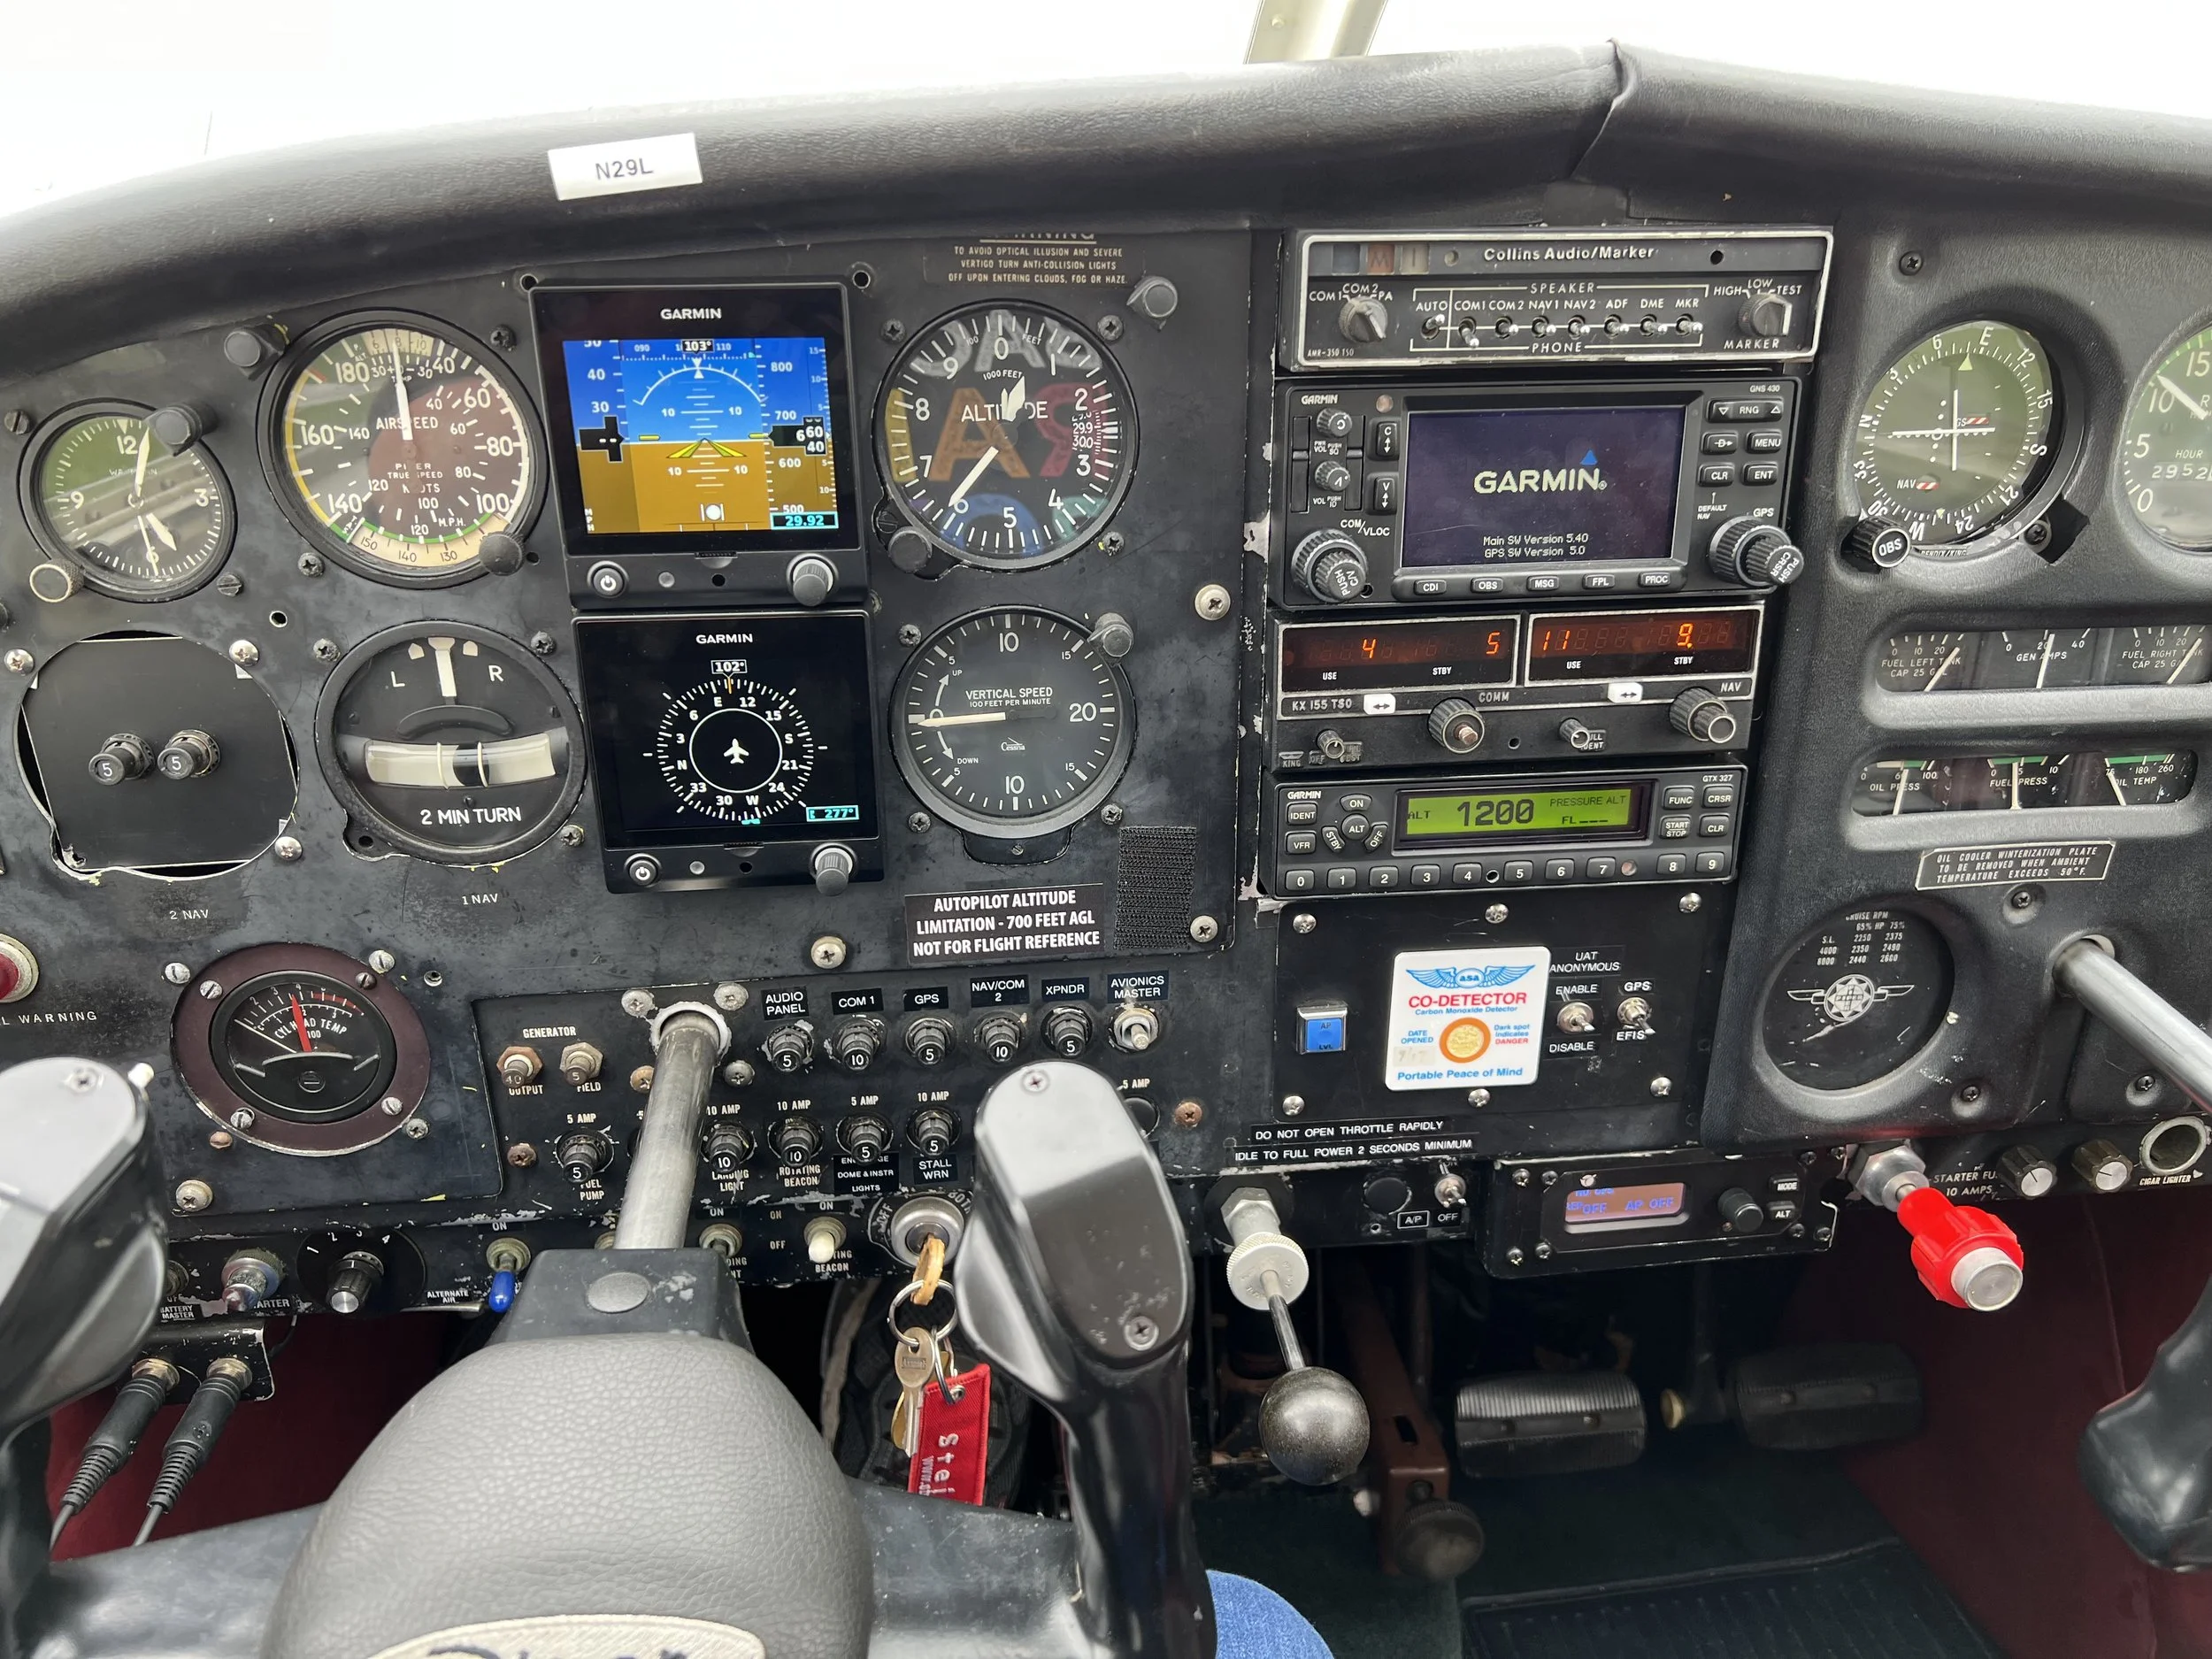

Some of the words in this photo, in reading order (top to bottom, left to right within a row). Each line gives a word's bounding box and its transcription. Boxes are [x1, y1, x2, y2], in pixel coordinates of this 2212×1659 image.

[595, 157, 654, 180] N29L
[954, 246, 964, 255] TO
[969, 246, 993, 256] AVOID
[996, 247, 1029, 256] OPTICAL
[1033, 247, 1069, 257] ILLUSION
[1073, 248, 1089, 257] AND
[1093, 248, 1123, 257] SEVERE
[1484, 248, 1540, 261] Collins
[1544, 246, 1655, 261] Audio/Marker
[961, 259, 994, 268] VERTIGO
[998, 259, 1018, 269] TURN
[1023, 260, 1085, 270] ANTI-COLLISION
[1088, 261, 1117, 271] LIGHTS
[949, 273, 963, 282] OFF
[967, 273, 988, 282] UPON
[992, 273, 1030, 283] ENTERING
[1071, 274, 1087, 284] FOG
[1091, 275, 1102, 284] OR
[1747, 279, 1772, 289] LOW
[1530, 282, 1594, 295] SPEAKER
[1714, 286, 1741, 296] HIGH
[1776, 285, 1802, 296] TEST
[1416, 301, 1448, 311] AUTO
[1605, 299, 1628, 309] ADF
[1640, 298, 1664, 309] DME
[1675, 298, 1699, 308] MKR
[660, 308, 722, 320] GARMIN
[1532, 342, 1582, 353] PHONE
[1724, 338, 1780, 349] MARKER
[335, 362, 370, 383] 180
[915, 397, 930, 421] 8
[1739, 406, 1759, 415] RNG
[301, 425, 334, 445] 160
[117, 435, 138, 455] 12
[487, 436, 514, 457] 80
[1755, 438, 1781, 448] MENU
[2175, 449, 2203, 460] HOUR
[1473, 468, 1600, 494] GARMIN
[1711, 471, 1728, 480] CLR
[1754, 470, 1773, 480] ENT
[785, 515, 825, 527] 29.92
[1483, 535, 1504, 546] Main
[1507, 535, 1522, 545] SW
[1524, 534, 1563, 545] Version
[1565, 533, 1589, 543] 5.40
[1485, 548, 1505, 558] GPS
[1507, 548, 1522, 557] SW
[1524, 546, 1563, 557] Version
[1570, 545, 1586, 556] 5.0
[1878, 537, 1902, 557] OBS
[1479, 580, 1498, 590] OBS
[1534, 579, 1555, 588] MSG
[1592, 577, 1609, 587] FPL
[1645, 574, 1668, 585] PROC
[1423, 582, 1439, 592] CDI
[695, 633, 753, 644] GARMIN
[1566, 661, 1581, 670] USE
[1674, 656, 1694, 665] STBY
[1322, 672, 1337, 680] USE
[1432, 666, 1452, 676] STBY
[1720, 681, 1741, 692] NAV
[965, 687, 1017, 701] VERTICAL
[1018, 687, 1053, 698] SPEED
[1479, 692, 1509, 703] COMM
[1292, 700, 1306, 711] KX
[1310, 699, 1327, 710] 155
[1069, 702, 1097, 723] 20
[1287, 790, 1322, 799] GARMIN
[1669, 795, 1693, 804] FUNC
[1549, 796, 1603, 807] PRESSURE
[1606, 795, 1626, 804] ALT
[420, 809, 433, 826] 2
[437, 808, 470, 826] MIN
[472, 806, 522, 824] TURN
[1290, 811, 1316, 820] IDENT
[1456, 798, 1534, 826] 1200
[1707, 824, 1724, 833] CLR
[1937, 854, 1951, 864] OIL
[1959, 851, 1991, 862] COOLER
[1998, 849, 2061, 859] WINTERIZATION
[2069, 847, 2098, 856] PLATE
[1939, 864, 1949, 873] TO
[1975, 861, 2014, 871] REMOVED
[2020, 858, 2045, 868] WHEN
[2051, 856, 2090, 866] AMBIENT
[1936, 871, 1998, 884] TEMPERATURE
[2008, 869, 2049, 879] EXCEEDS
[933, 893, 1010, 913] AUTOPILOT
[1012, 889, 1077, 908] ALTITUDE
[916, 916, 995, 936] LIMITATION
[1006, 914, 1032, 930] 700
[1035, 912, 1067, 928] FEET
[1069, 910, 1095, 926] AGL
[913, 941, 943, 957] NOT
[944, 939, 972, 956] FOR
[974, 935, 1022, 954] FLIGHT
[1025, 931, 1101, 951] REFERENCE
[1575, 951, 1598, 962] UAT
[1549, 962, 1620, 973] ANONYMOUS
[972, 979, 1025, 992] NAV/COM
[1110, 975, 1164, 988] AVIONICS
[1624, 980, 1652, 992] GPS
[1045, 984, 1085, 995] XPNDR
[1114, 987, 1162, 999] MASTER
[1555, 984, 1598, 995] ENABLE
[765, 991, 804, 1004] AUDIO
[838, 996, 867, 1008] COM
[870, 995, 875, 1005] 1
[914, 994, 940, 1005] GPS
[995, 992, 1002, 1002] 2
[1409, 992, 1527, 1008] CO-DETECTOR
[766, 1003, 806, 1016] PANEL
[18, 1010, 97, 1025] WARNING
[522, 1025, 577, 1039] GENERATOR
[1616, 1031, 1646, 1041] EFIS
[1549, 1041, 1595, 1053] DISABLE
[1397, 1071, 1444, 1080] Portable
[1447, 1069, 1479, 1079] Peace
[1483, 1068, 1494, 1077] of
[1496, 1067, 1524, 1077] Mind
[1256, 1131, 1272, 1141] DO
[1277, 1129, 1300, 1139] NOT
[1304, 1127, 1335, 1138] OPEN
[1340, 1123, 1394, 1135] THROTTLE
[1399, 1120, 1444, 1132] RAPIDLY
[1234, 1151, 1258, 1161] IDLE
[1263, 1150, 1279, 1160] TO
[1283, 1148, 1310, 1159] FULL
[1314, 1146, 1353, 1157] POWER
[1357, 1146, 1364, 1155] 2
[1369, 1142, 1420, 1154] SECONDS
[1425, 1139, 1473, 1150] MINIMUM
[918, 1158, 952, 1169] STALL
[923, 1169, 949, 1180] WRN
[2139, 1176, 2161, 1186] CIGAR
[2162, 1174, 2192, 1185] LIGHTER
